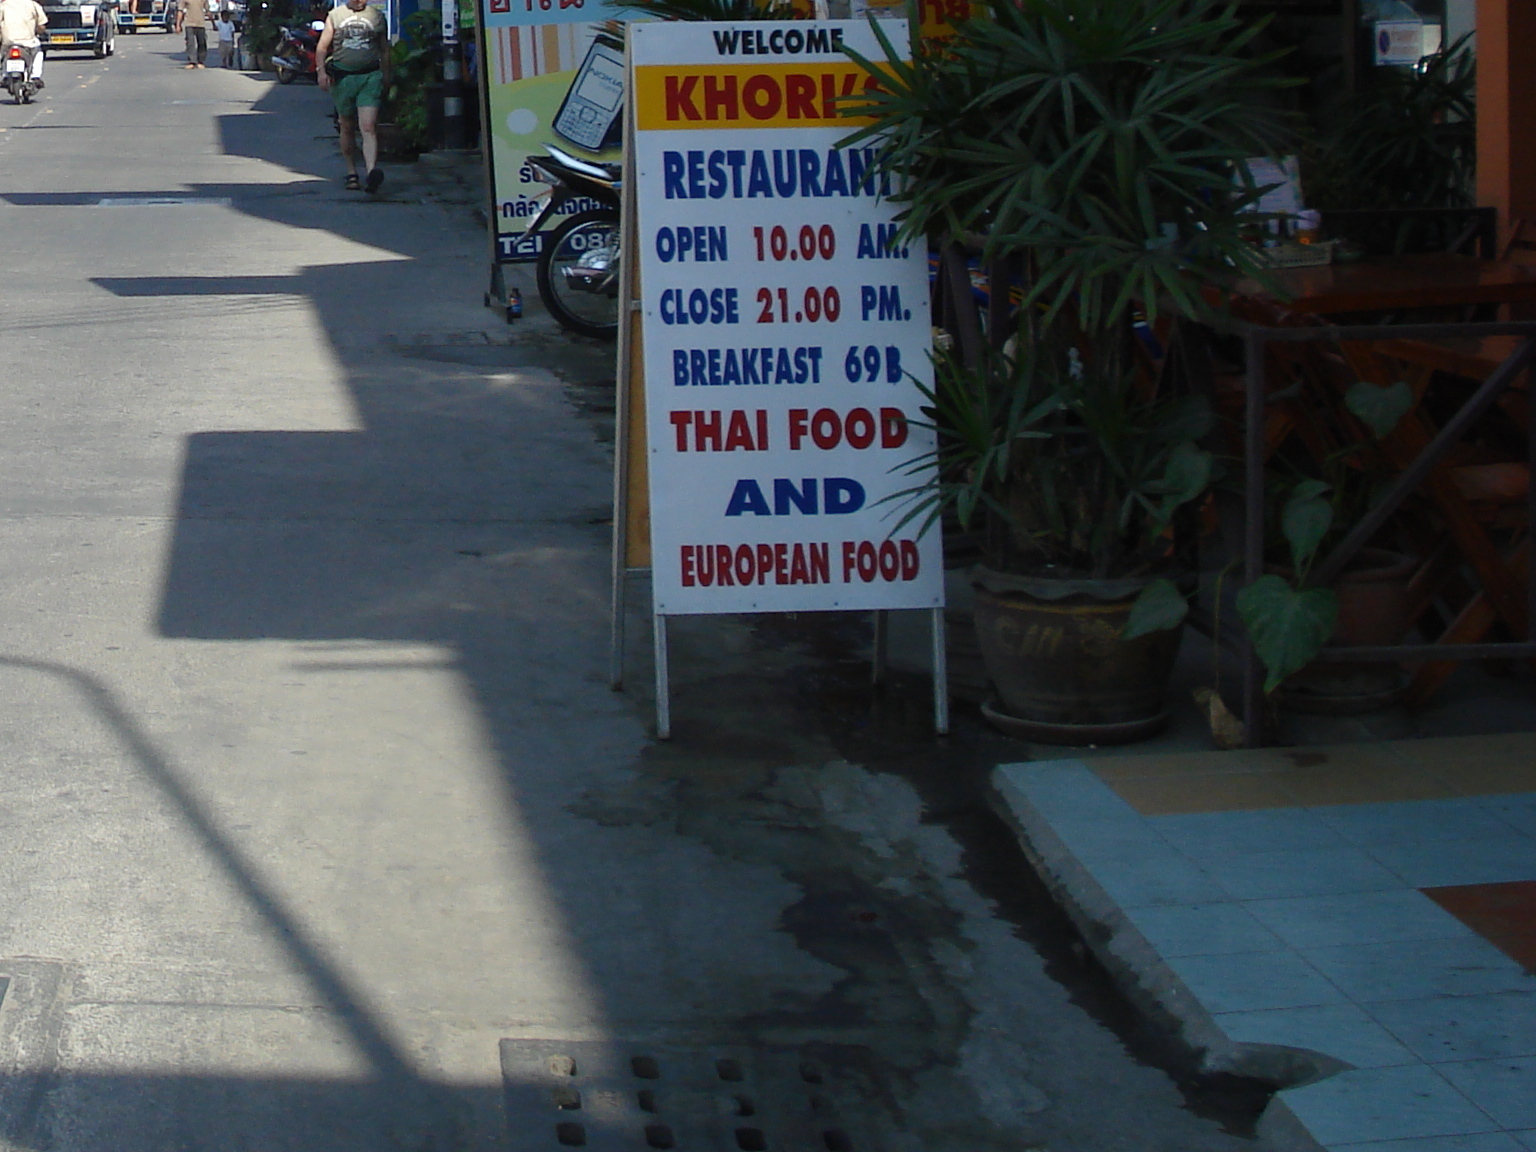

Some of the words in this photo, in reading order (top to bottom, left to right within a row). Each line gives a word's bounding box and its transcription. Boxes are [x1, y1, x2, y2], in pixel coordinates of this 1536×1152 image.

[713, 27, 844, 56] WELCOME
[663, 148, 894, 200] RESTAURANT
[655, 225, 728, 263] OPEN
[752, 224, 836, 262] 10.00
[659, 287, 739, 326] CLOSE
[755, 285, 841, 324] 21.00
[860, 284, 912, 322] PM.
[673, 346, 823, 387] BREAKFAST
[669, 408, 769, 453] THAI
[788, 406, 909, 451] FOOD
[724, 476, 866, 518] AND
[679, 541, 830, 588] EUROPEAN
[841, 538, 921, 583] FOOD
